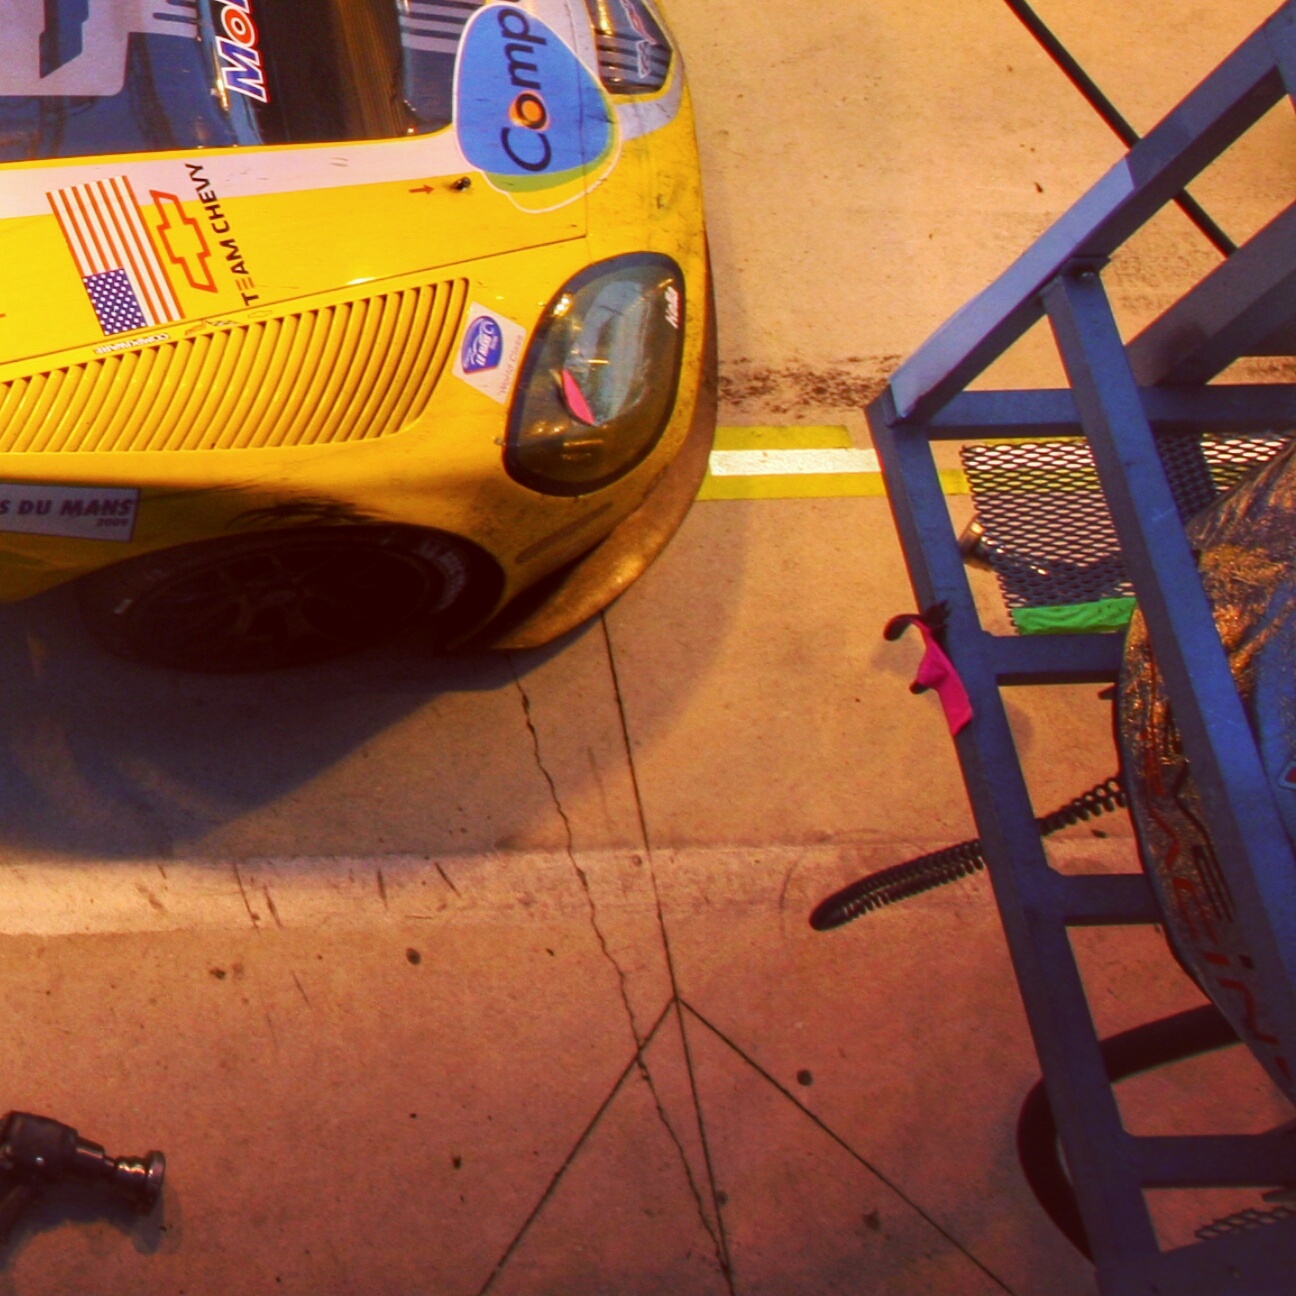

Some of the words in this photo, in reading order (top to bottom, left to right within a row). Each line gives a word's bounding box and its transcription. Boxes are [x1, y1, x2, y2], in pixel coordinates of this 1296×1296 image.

[184, 162, 230, 234] CHEVY
[218, 238, 260, 307] TEAM
[17, 498, 51, 517] DU
[57, 497, 134, 519] MANS
[96, 517, 131, 530] 2009
